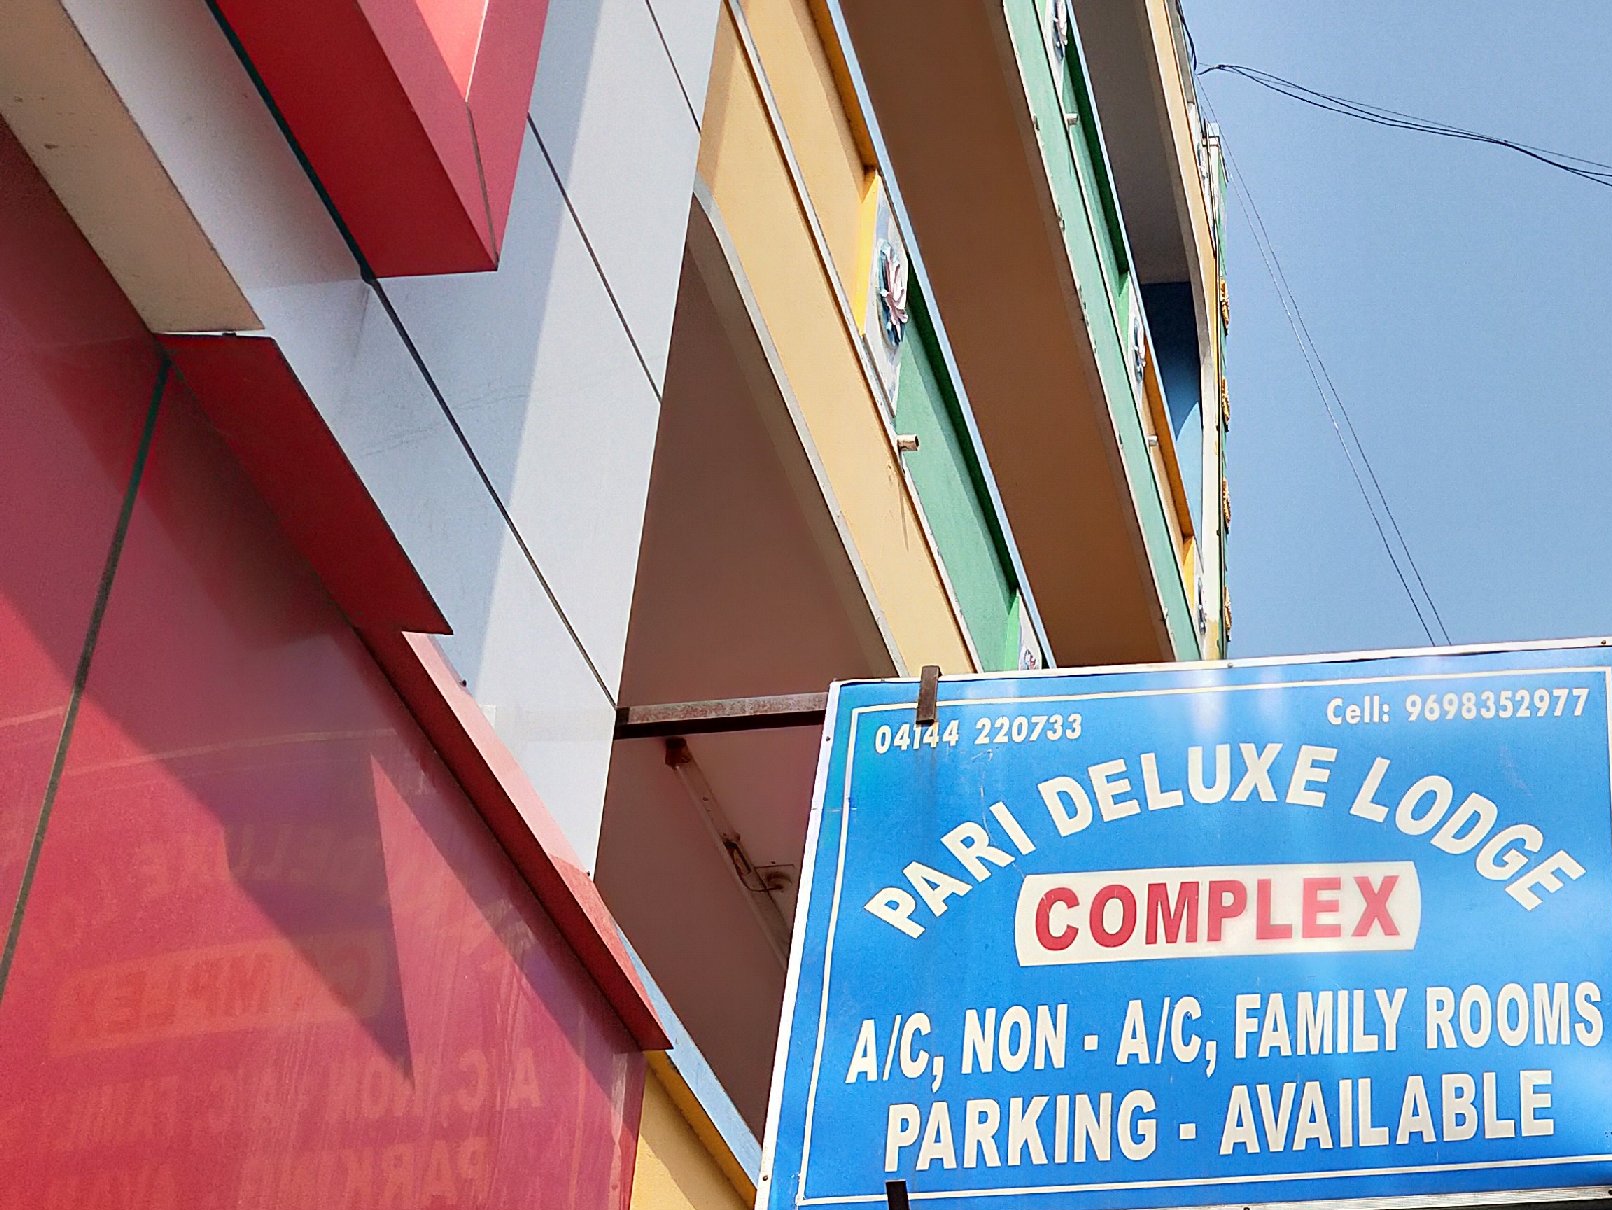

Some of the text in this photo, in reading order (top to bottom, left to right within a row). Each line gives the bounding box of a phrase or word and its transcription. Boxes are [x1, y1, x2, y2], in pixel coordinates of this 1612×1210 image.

[875, 713, 1082, 754] 04144 220733
[1326, 687, 1590, 725] Cell: 9698352977
[863, 742, 1587, 939] PARI DELUXE LODGE
[1035, 876, 1400, 952] COMPLEX
[845, 981, 1604, 1093] A/C, NON - A/C, FAMILY ROOMS
[884, 1069, 1554, 1173] PARKING - AVAILABLE
